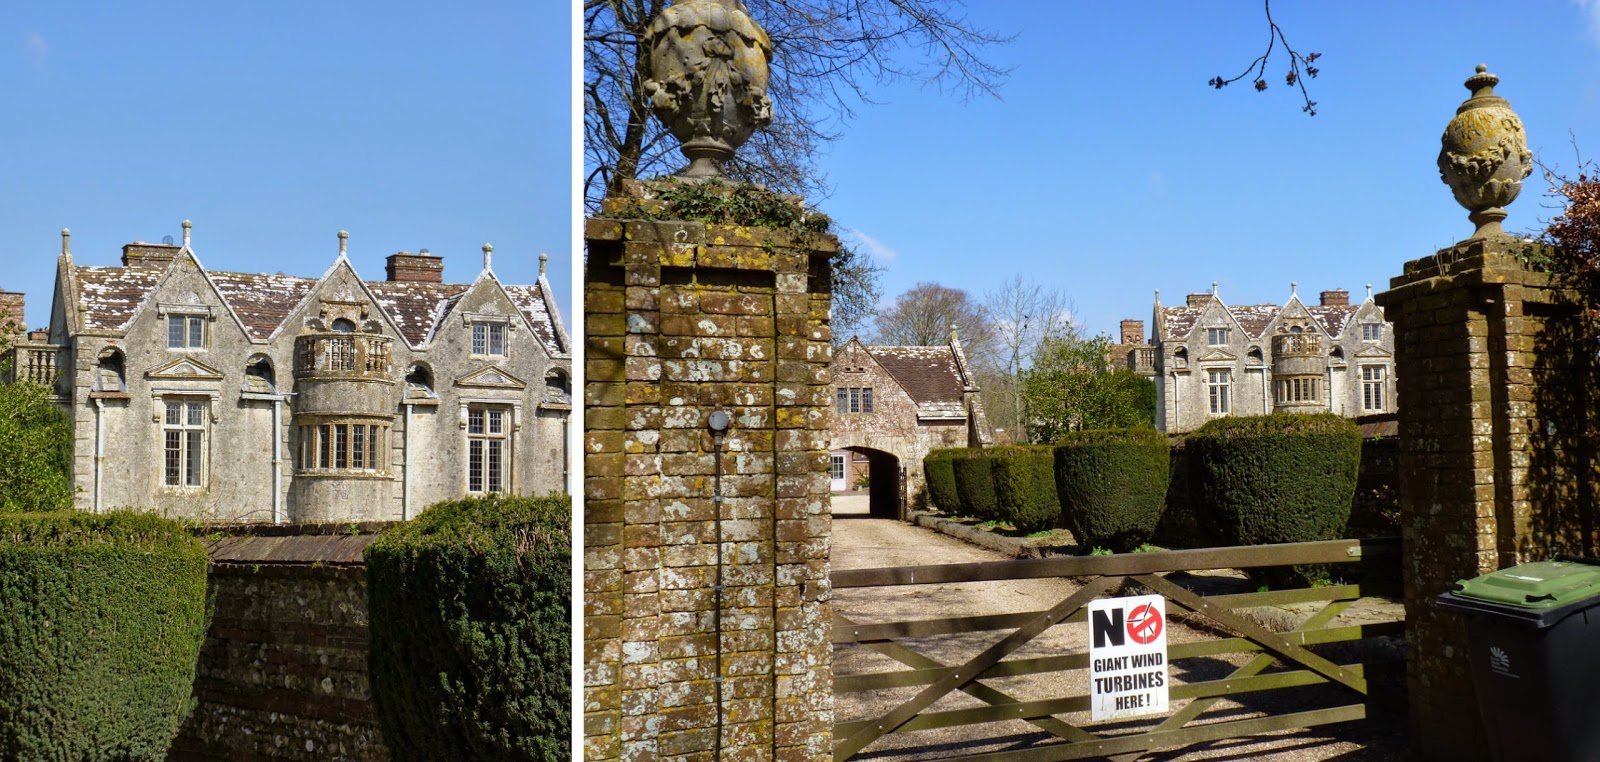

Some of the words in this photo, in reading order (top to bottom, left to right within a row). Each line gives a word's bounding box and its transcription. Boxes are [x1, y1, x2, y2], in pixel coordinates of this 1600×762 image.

[1092, 603, 1163, 648] NO
[1094, 656, 1128, 673] GIANT
[1131, 652, 1163, 668] WIND
[1095, 671, 1164, 694] TURBINES
